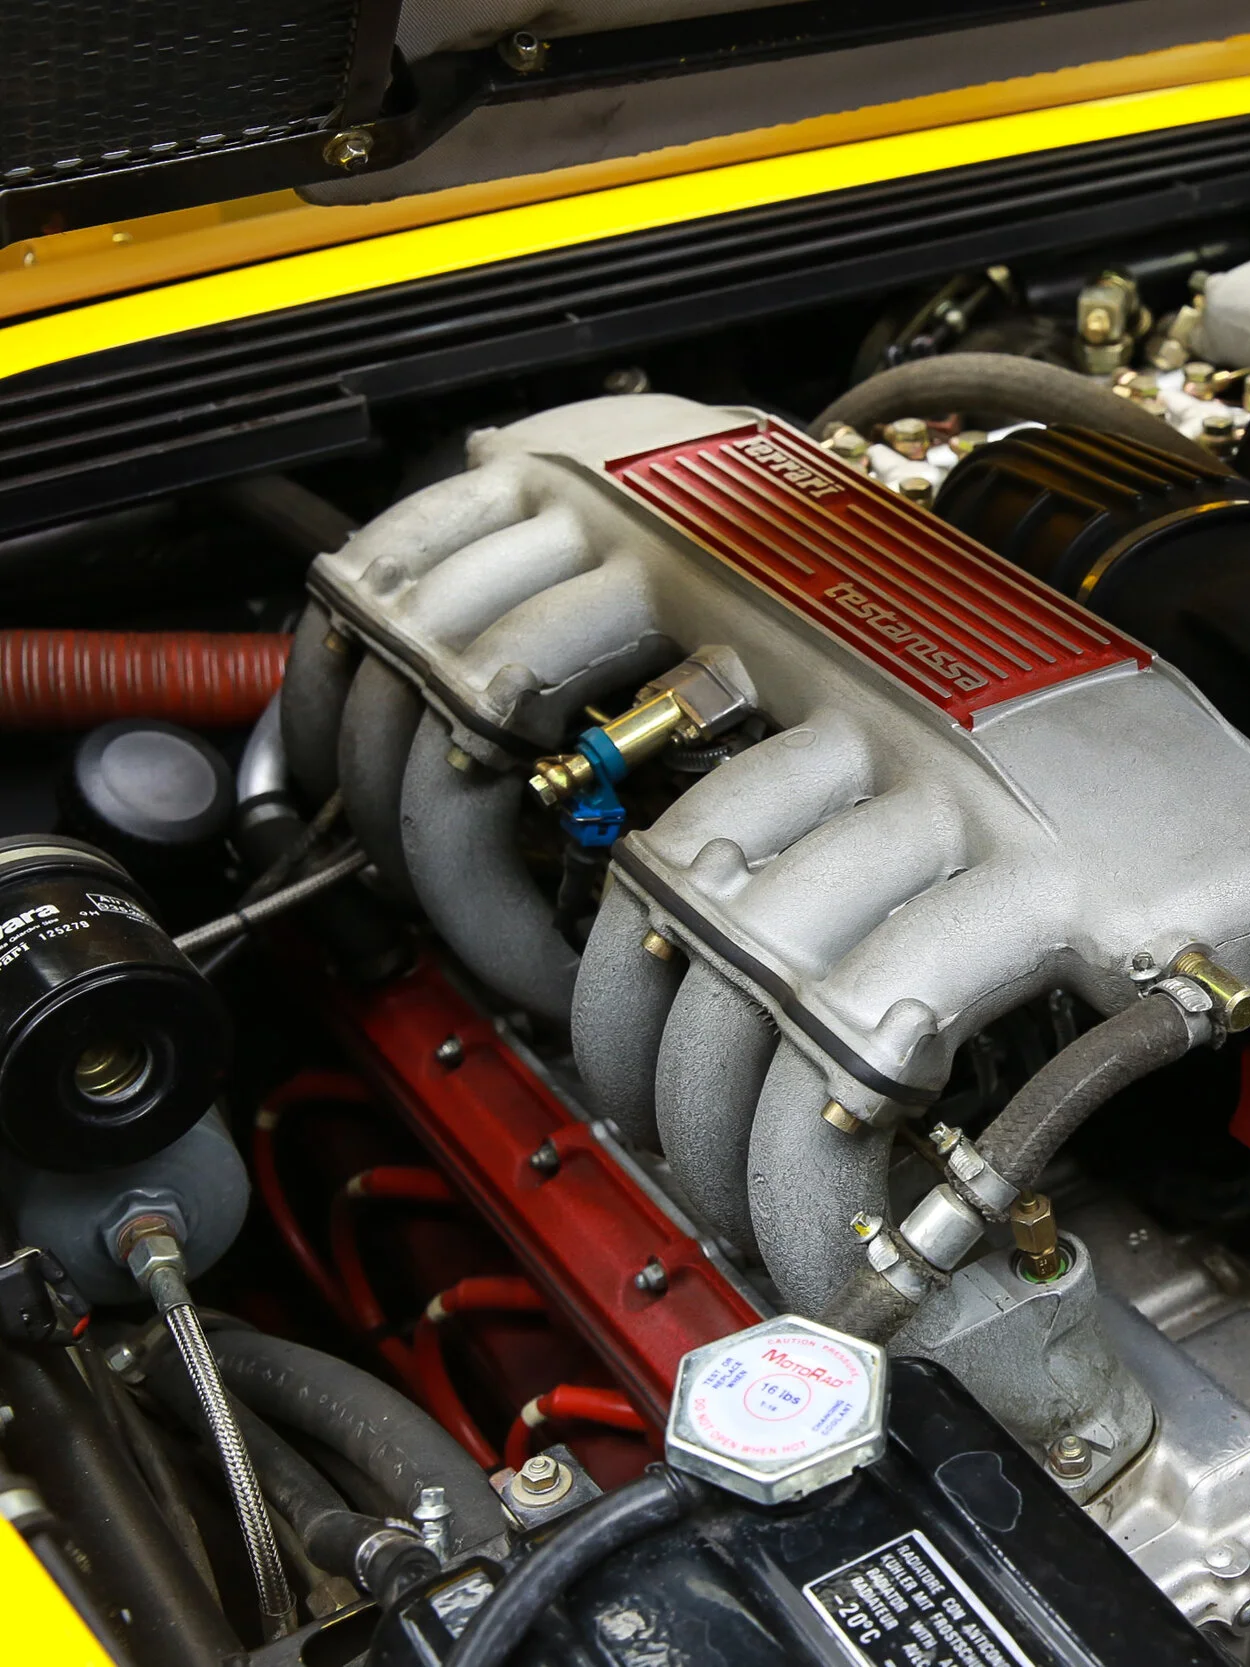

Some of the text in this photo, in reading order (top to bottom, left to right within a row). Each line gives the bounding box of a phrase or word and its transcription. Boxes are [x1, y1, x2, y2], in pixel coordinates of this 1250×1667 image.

[733, 434, 846, 499] Ferrari
[823, 581, 990, 692] testarossa
[703, 1370, 720, 1385] TEST
[712, 1361, 743, 1389] REPLACE
[767, 1338, 861, 1378] CAUTION PRESSURE
[761, 1382, 801, 1405] 16 lbs
[710, 1431, 737, 1449] OPEN
[741, 1445, 777, 1456] WHEN
[782, 1440, 807, 1452] HOT
[850, 1576, 899, 1631] RADIATEUR
[897, 1544, 946, 1596] RADIATORE
[941, 1597, 967, 1621] CON
[911, 1590, 935, 1611] MIT
[834, 1594, 882, 1645] -20°C
[866, 1567, 938, 1650] RADIATOR WITH
